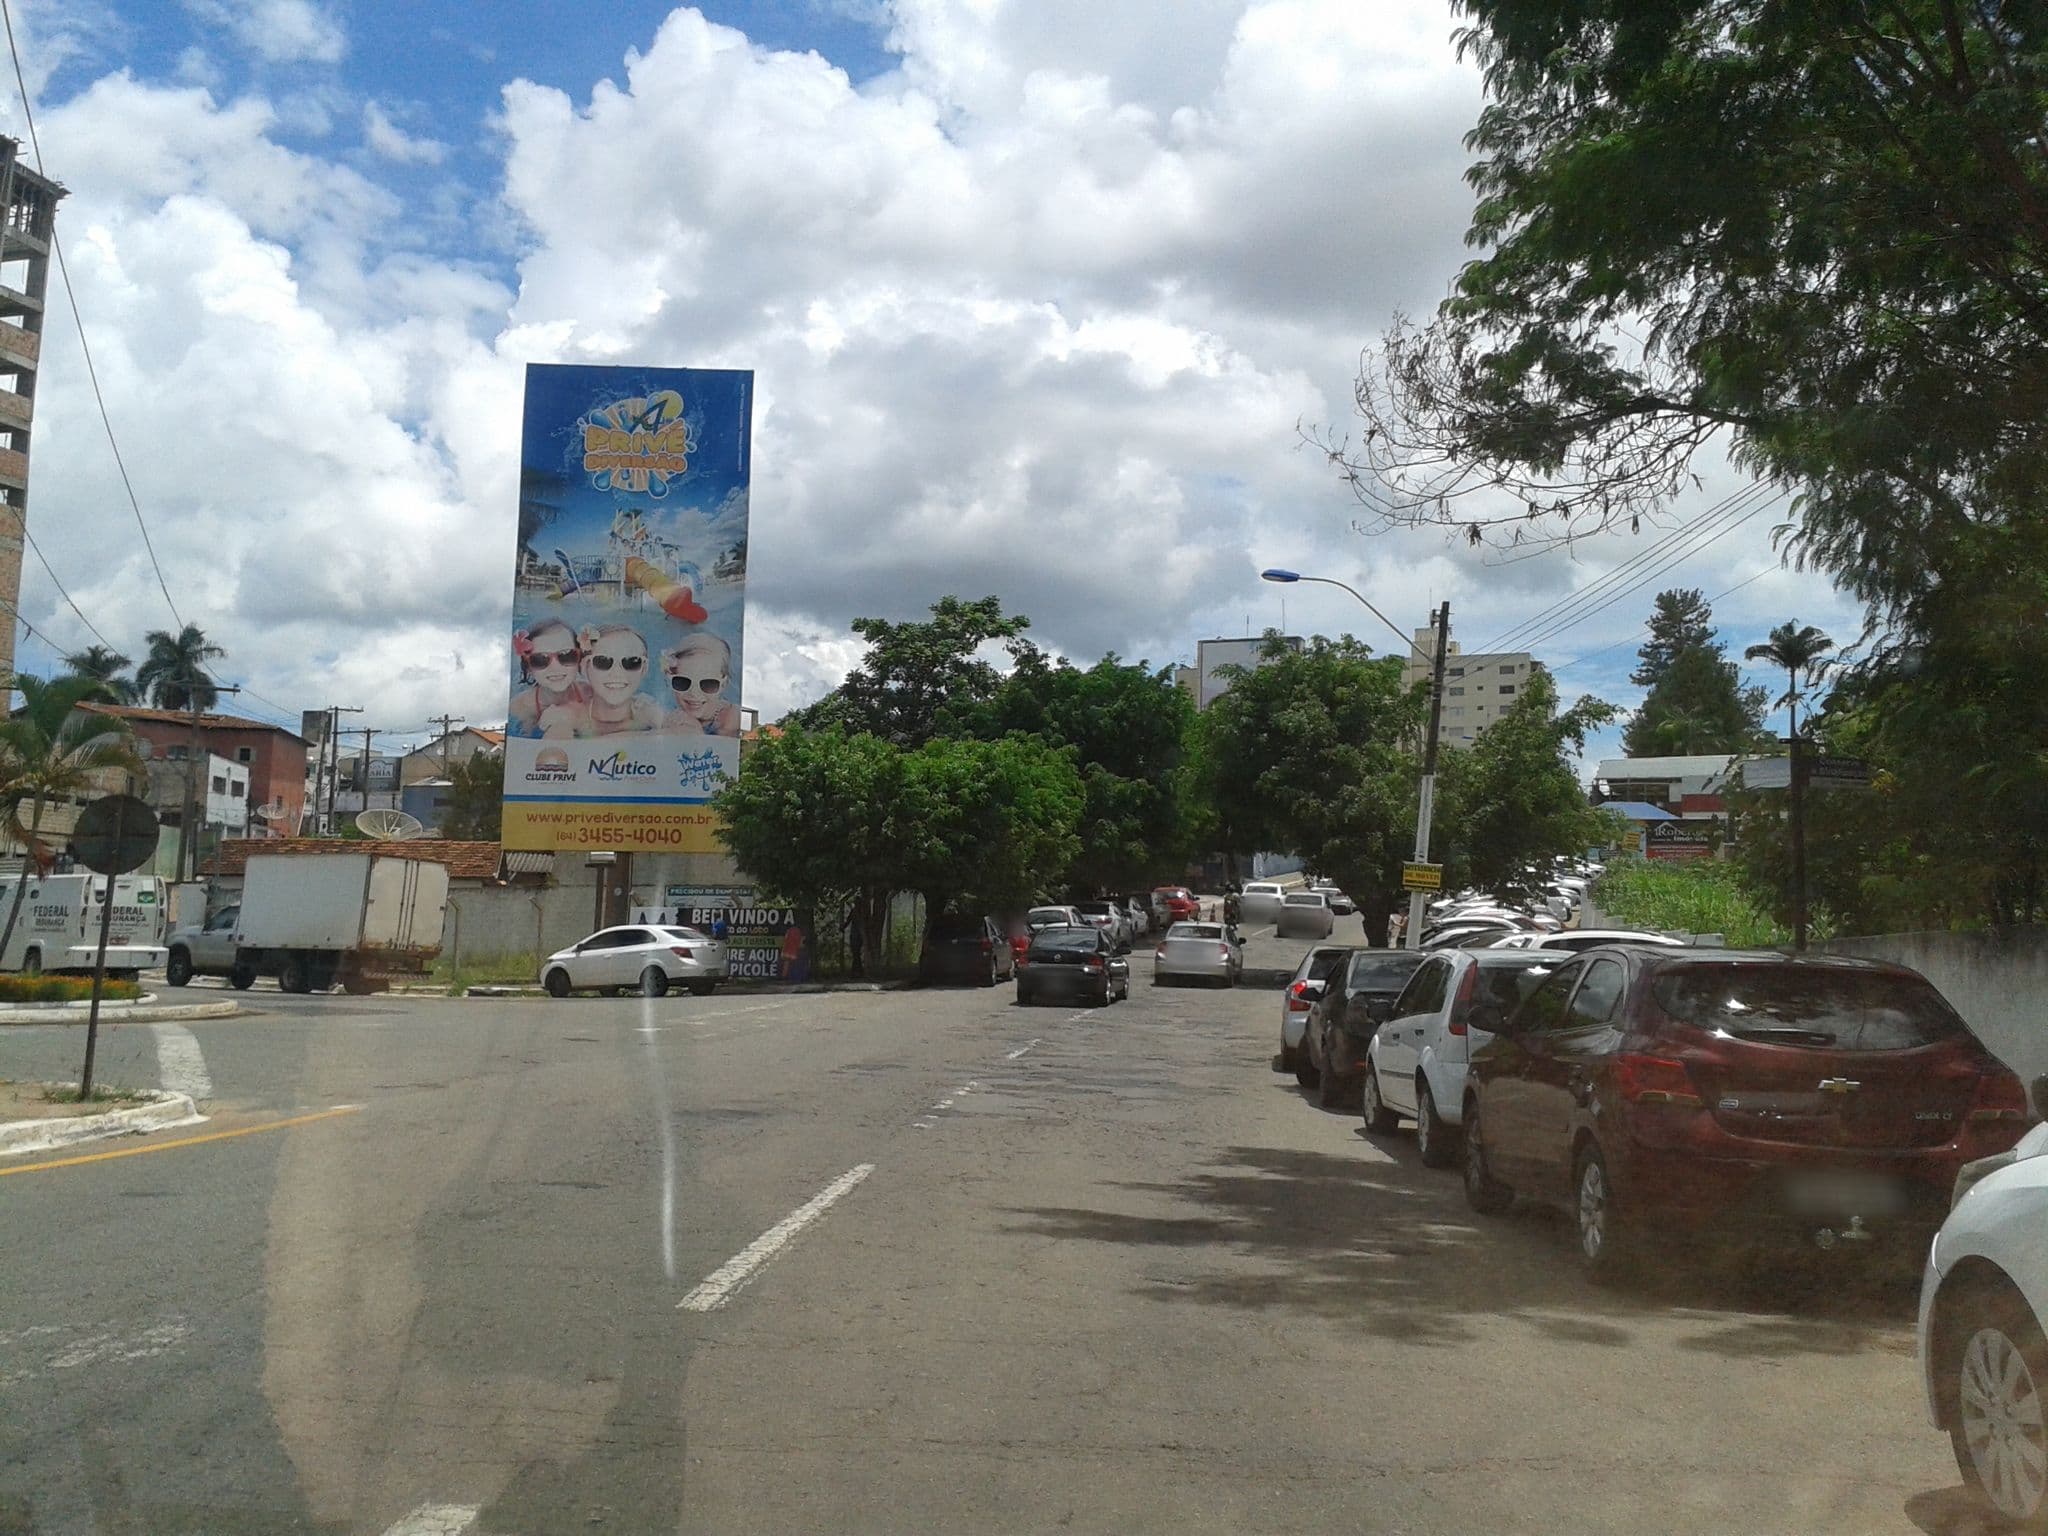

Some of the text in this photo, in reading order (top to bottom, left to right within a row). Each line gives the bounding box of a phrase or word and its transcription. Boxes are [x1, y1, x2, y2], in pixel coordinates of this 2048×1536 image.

[525, 772, 577, 782] CLUBE PRIVÉ
[526, 812, 712, 825] www.privediversao.com.br
[578, 827, 682, 844] 3455-4040
[33, 904, 70, 917] FEDERAL
[101, 905, 144, 916] FDERAL
[728, 908, 780, 925] VINDO
[783, 908, 795, 925] A
[748, 948, 779, 964] AQUI
[729, 962, 778, 977] PICOLÉ
